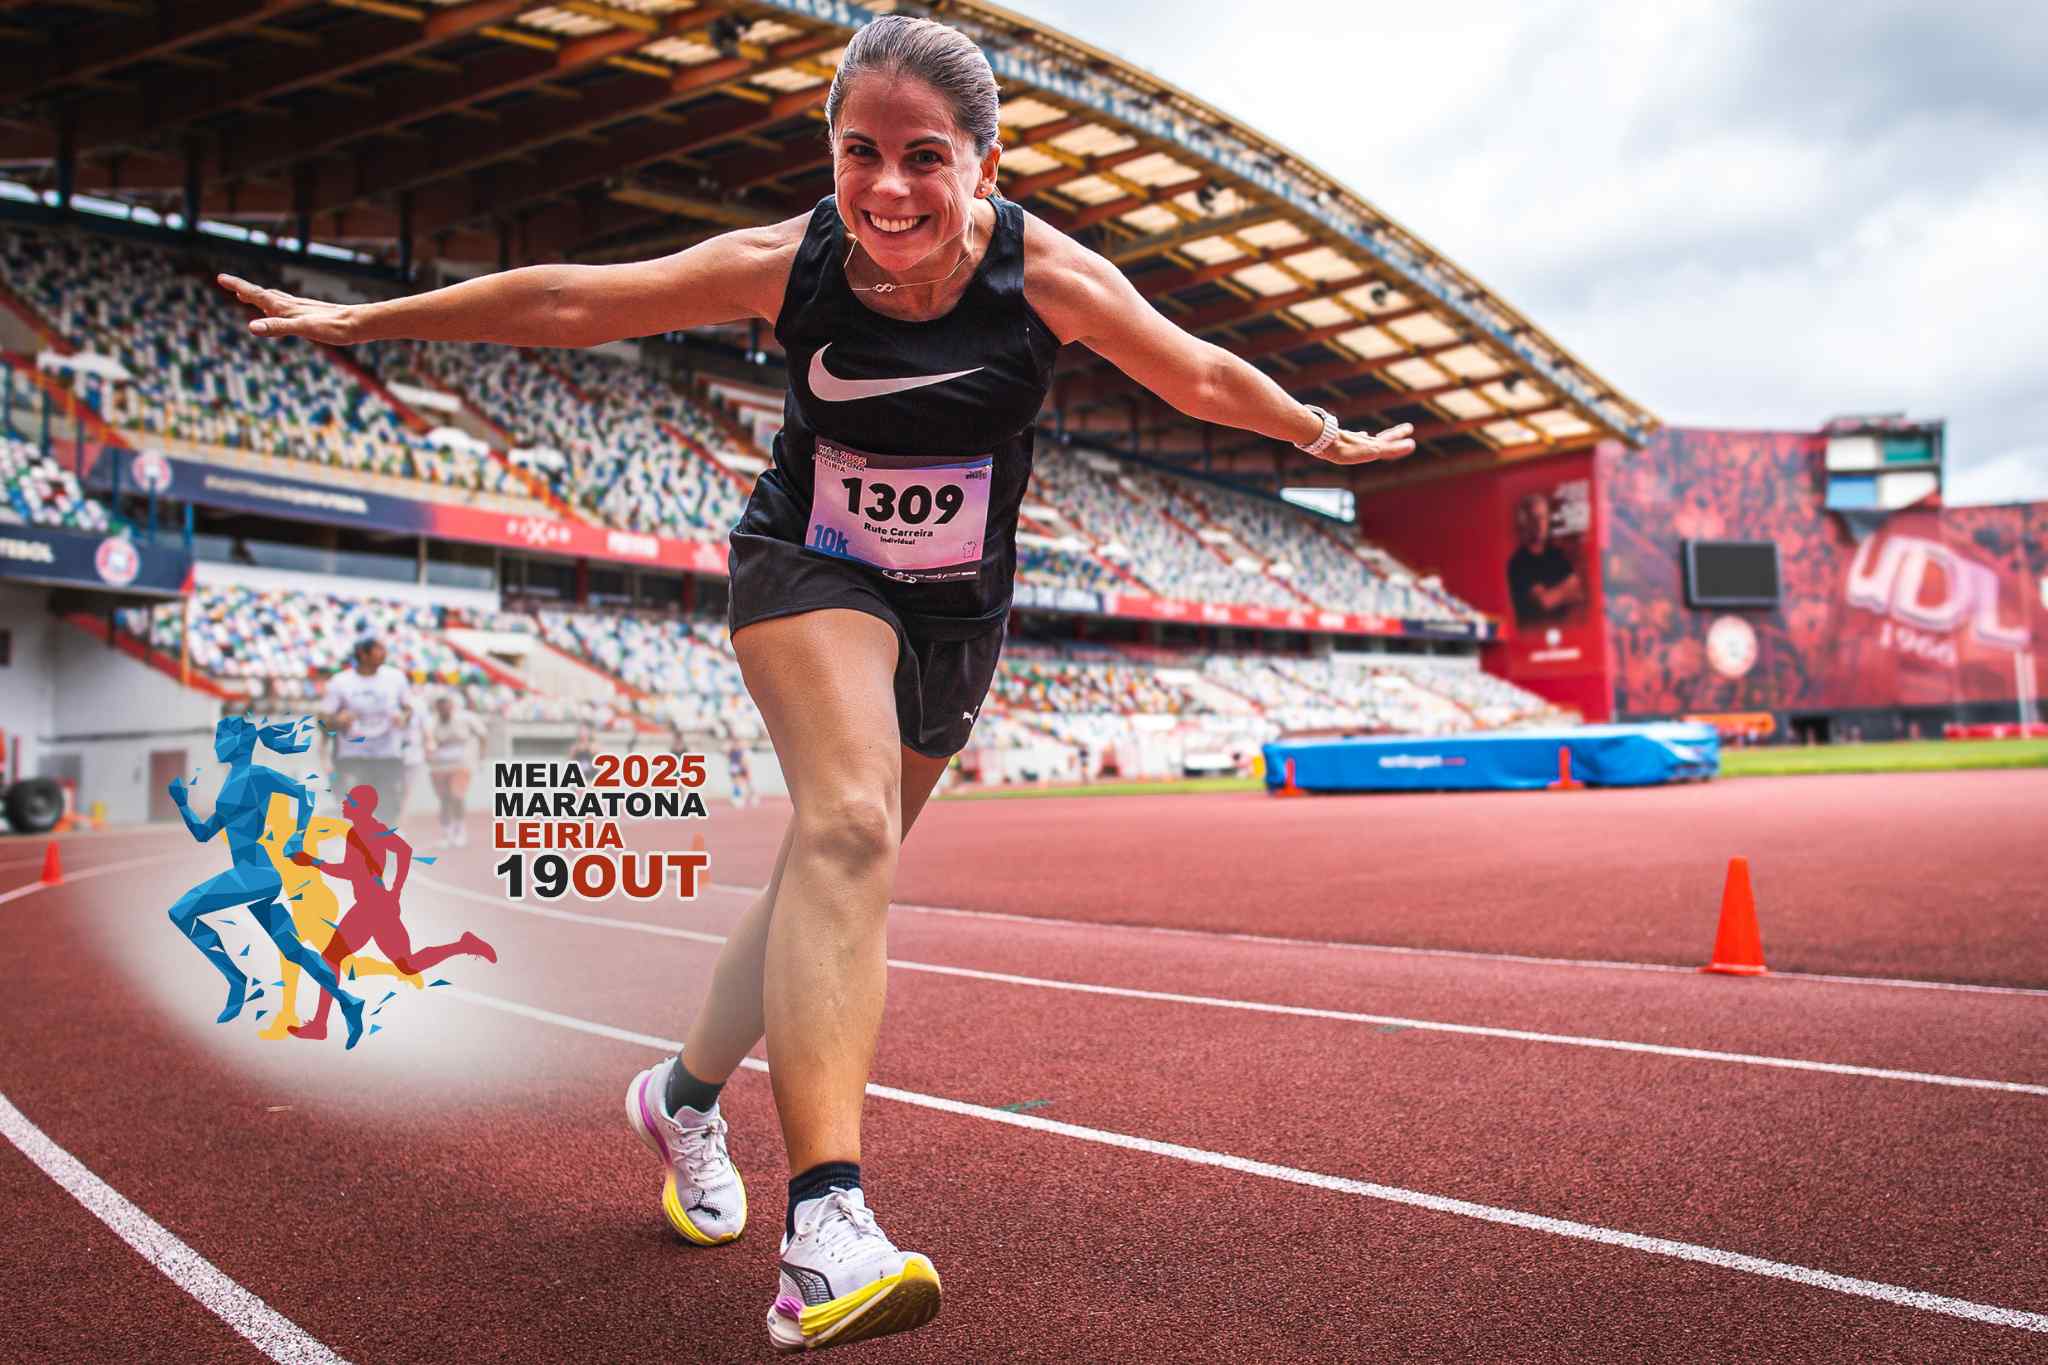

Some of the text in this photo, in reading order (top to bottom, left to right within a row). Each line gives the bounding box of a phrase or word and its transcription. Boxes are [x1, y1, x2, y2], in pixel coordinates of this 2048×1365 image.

[841, 477, 964, 525] 1309
[814, 524, 848, 554] 10k
[863, 522, 934, 538] Rute Carreira
[1847, 536, 2031, 648] UDL
